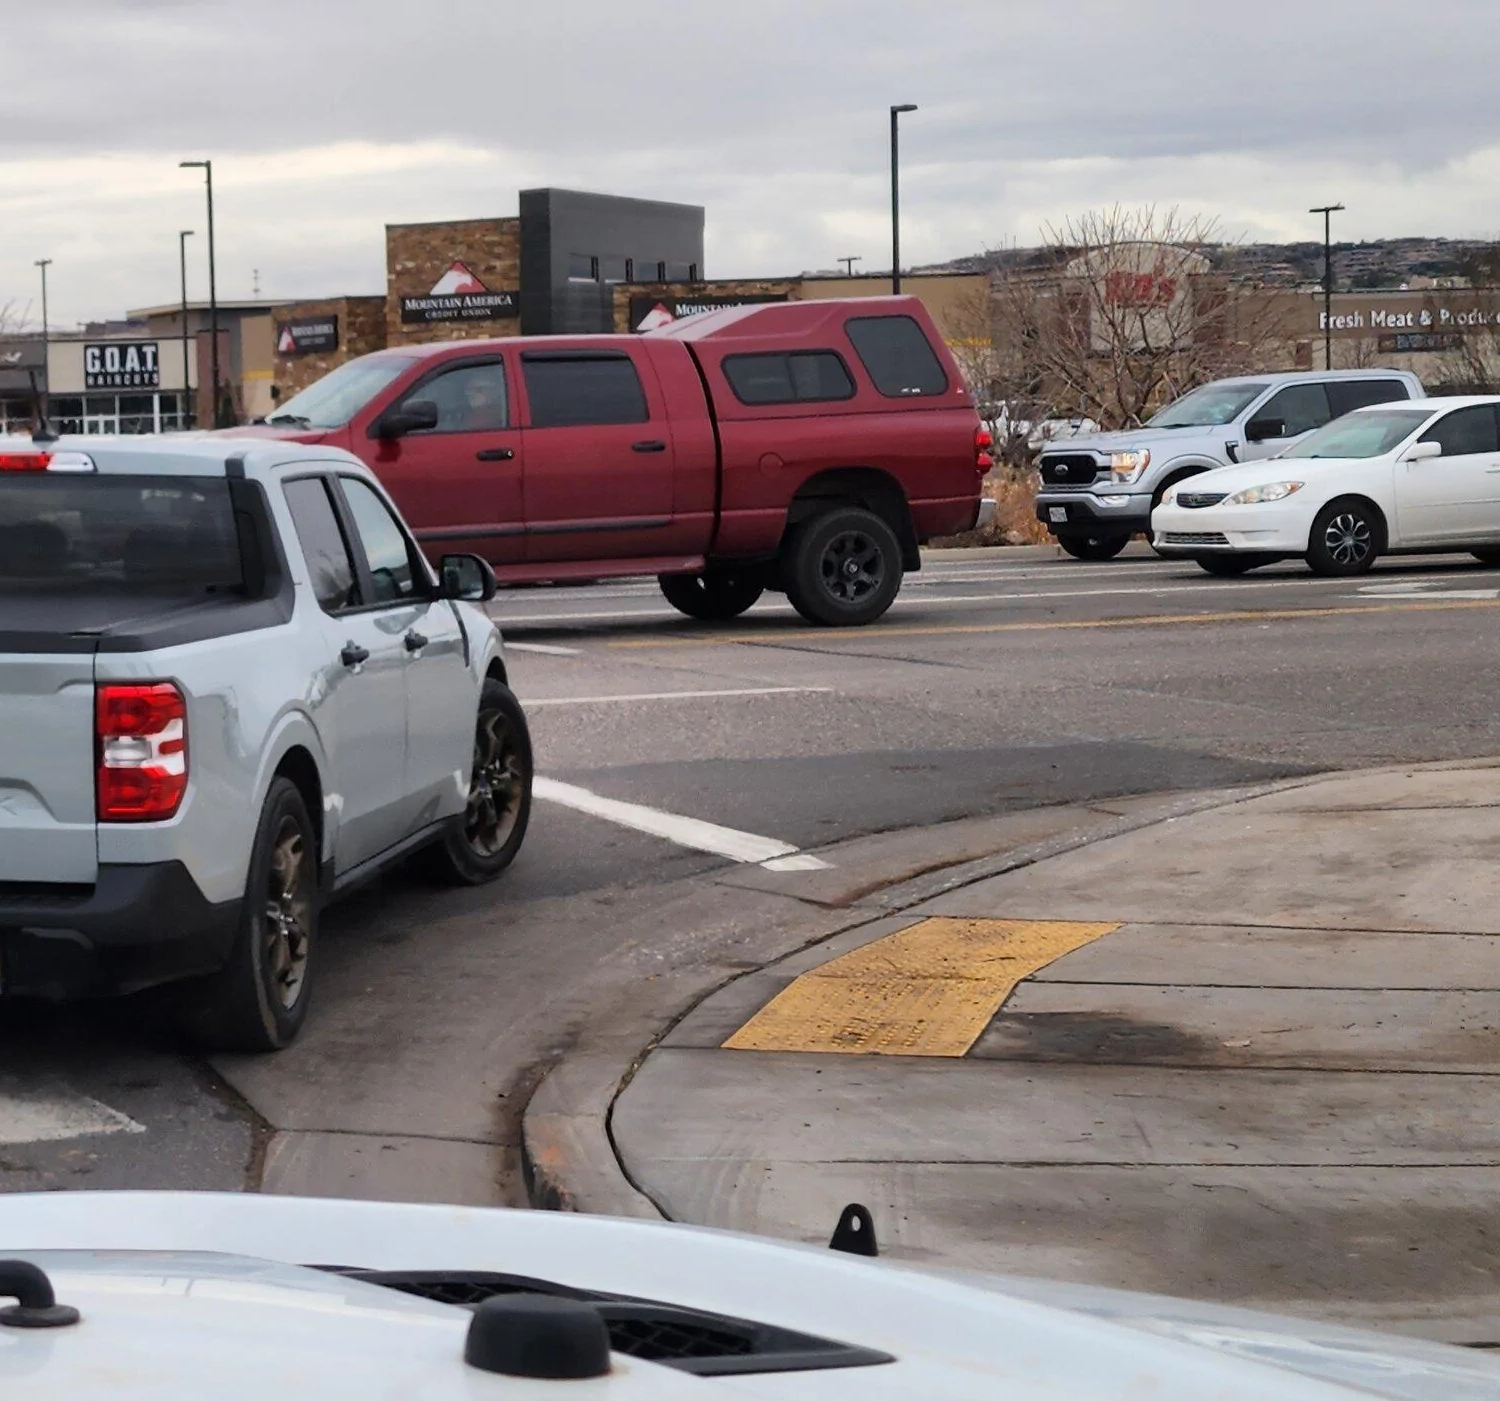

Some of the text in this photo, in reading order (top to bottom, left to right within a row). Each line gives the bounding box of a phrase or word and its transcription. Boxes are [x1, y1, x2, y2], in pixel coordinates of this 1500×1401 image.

[404, 294, 513, 311] MOUNTAIN AMERICA
[461, 309, 492, 317] UNION
[1319, 311, 1364, 329] Fresh
[1370, 310, 1414, 328] Meat
[1419, 308, 1434, 326] &
[86, 345, 158, 373] G.O.A.T.
[86, 373, 159, 386] HAIRCUTS
